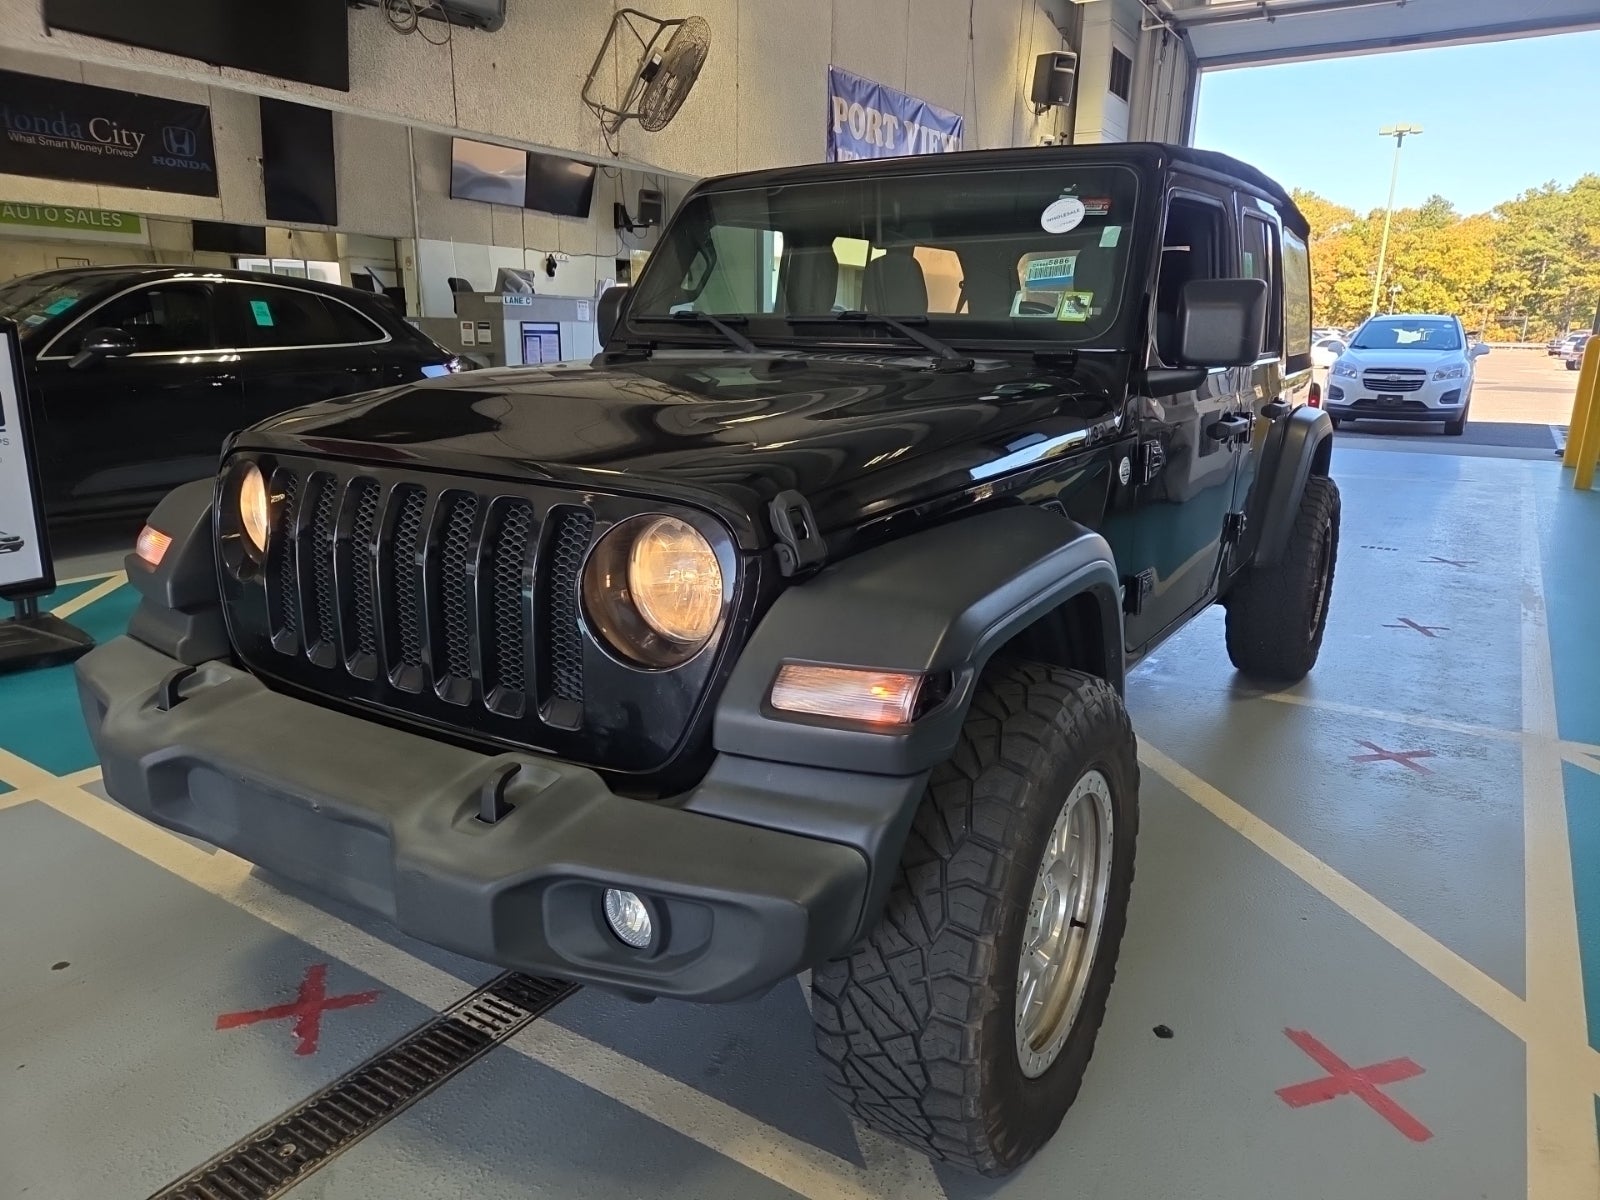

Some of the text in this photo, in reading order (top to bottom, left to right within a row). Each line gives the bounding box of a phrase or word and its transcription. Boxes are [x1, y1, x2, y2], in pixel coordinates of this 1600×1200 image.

[832, 96, 898, 149] PORT
[8, 132, 134, 158] What Smart Money Drives
[89, 117, 145, 154] City
[152, 155, 212, 172] HONDA
[2, 202, 122, 227] AUTO SALES
[504, 296, 531, 305] LANE C
